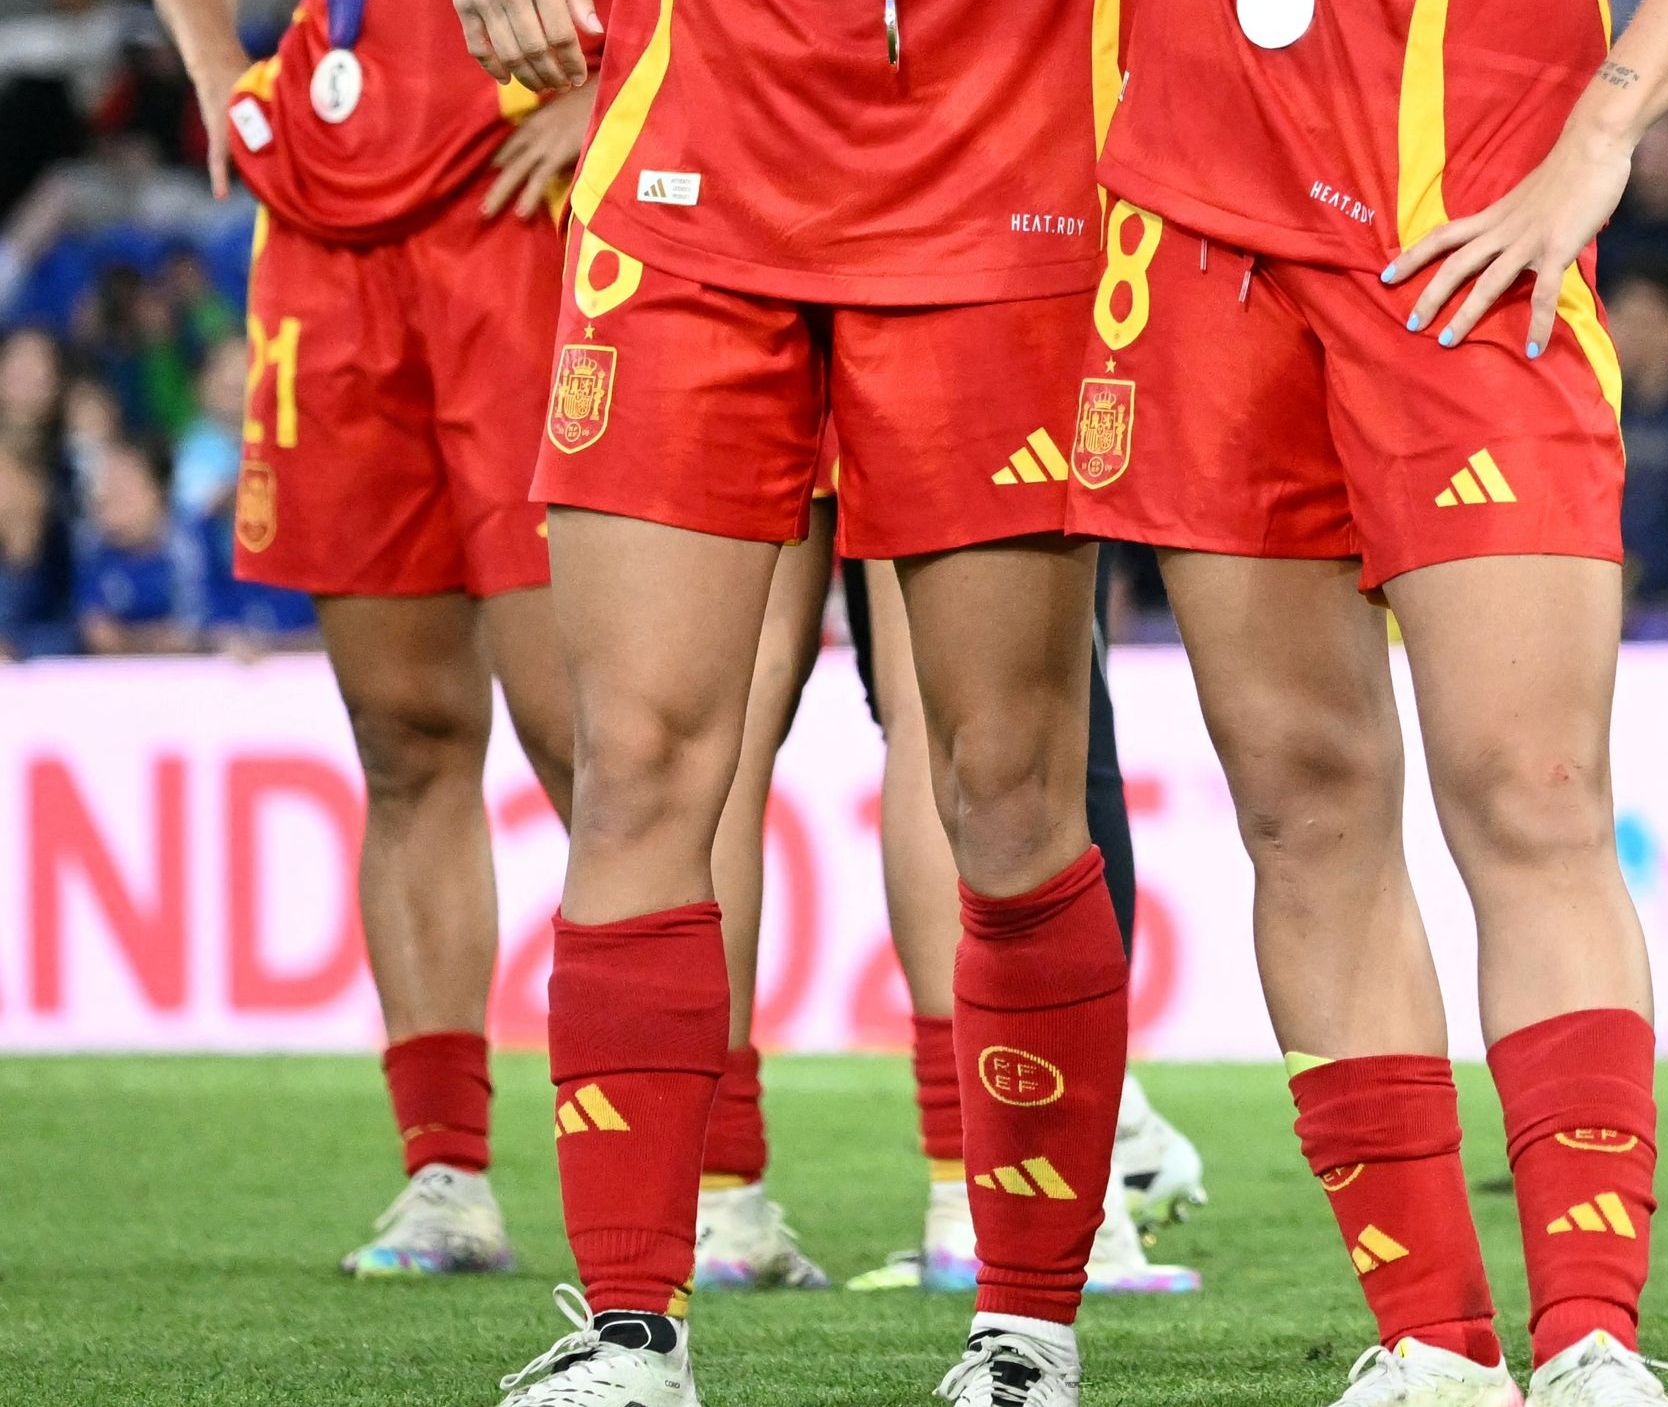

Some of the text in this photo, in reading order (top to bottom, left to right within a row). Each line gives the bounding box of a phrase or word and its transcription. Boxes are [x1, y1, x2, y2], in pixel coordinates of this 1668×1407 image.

[1011, 214, 1084, 235] HEAT.RDY
[1310, 180, 1376, 226] HEAT.RDY
[1093, 199, 1163, 351] 8
[0, 754, 367, 1016] ND
